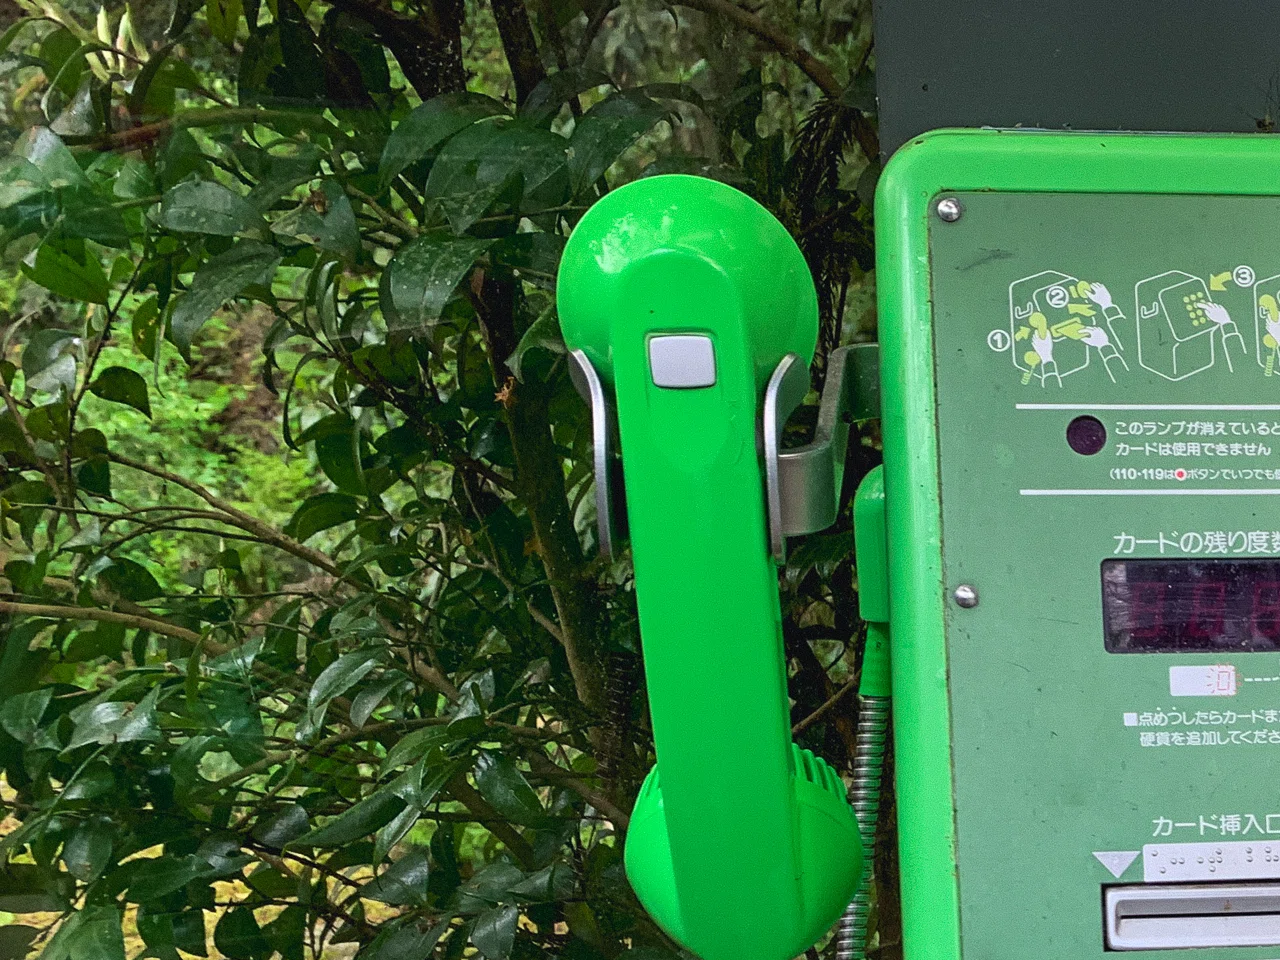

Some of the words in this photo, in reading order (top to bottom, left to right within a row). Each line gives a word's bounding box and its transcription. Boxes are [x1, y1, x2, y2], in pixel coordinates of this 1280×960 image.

[1115, 443, 1271, 456] カードは使用できません
